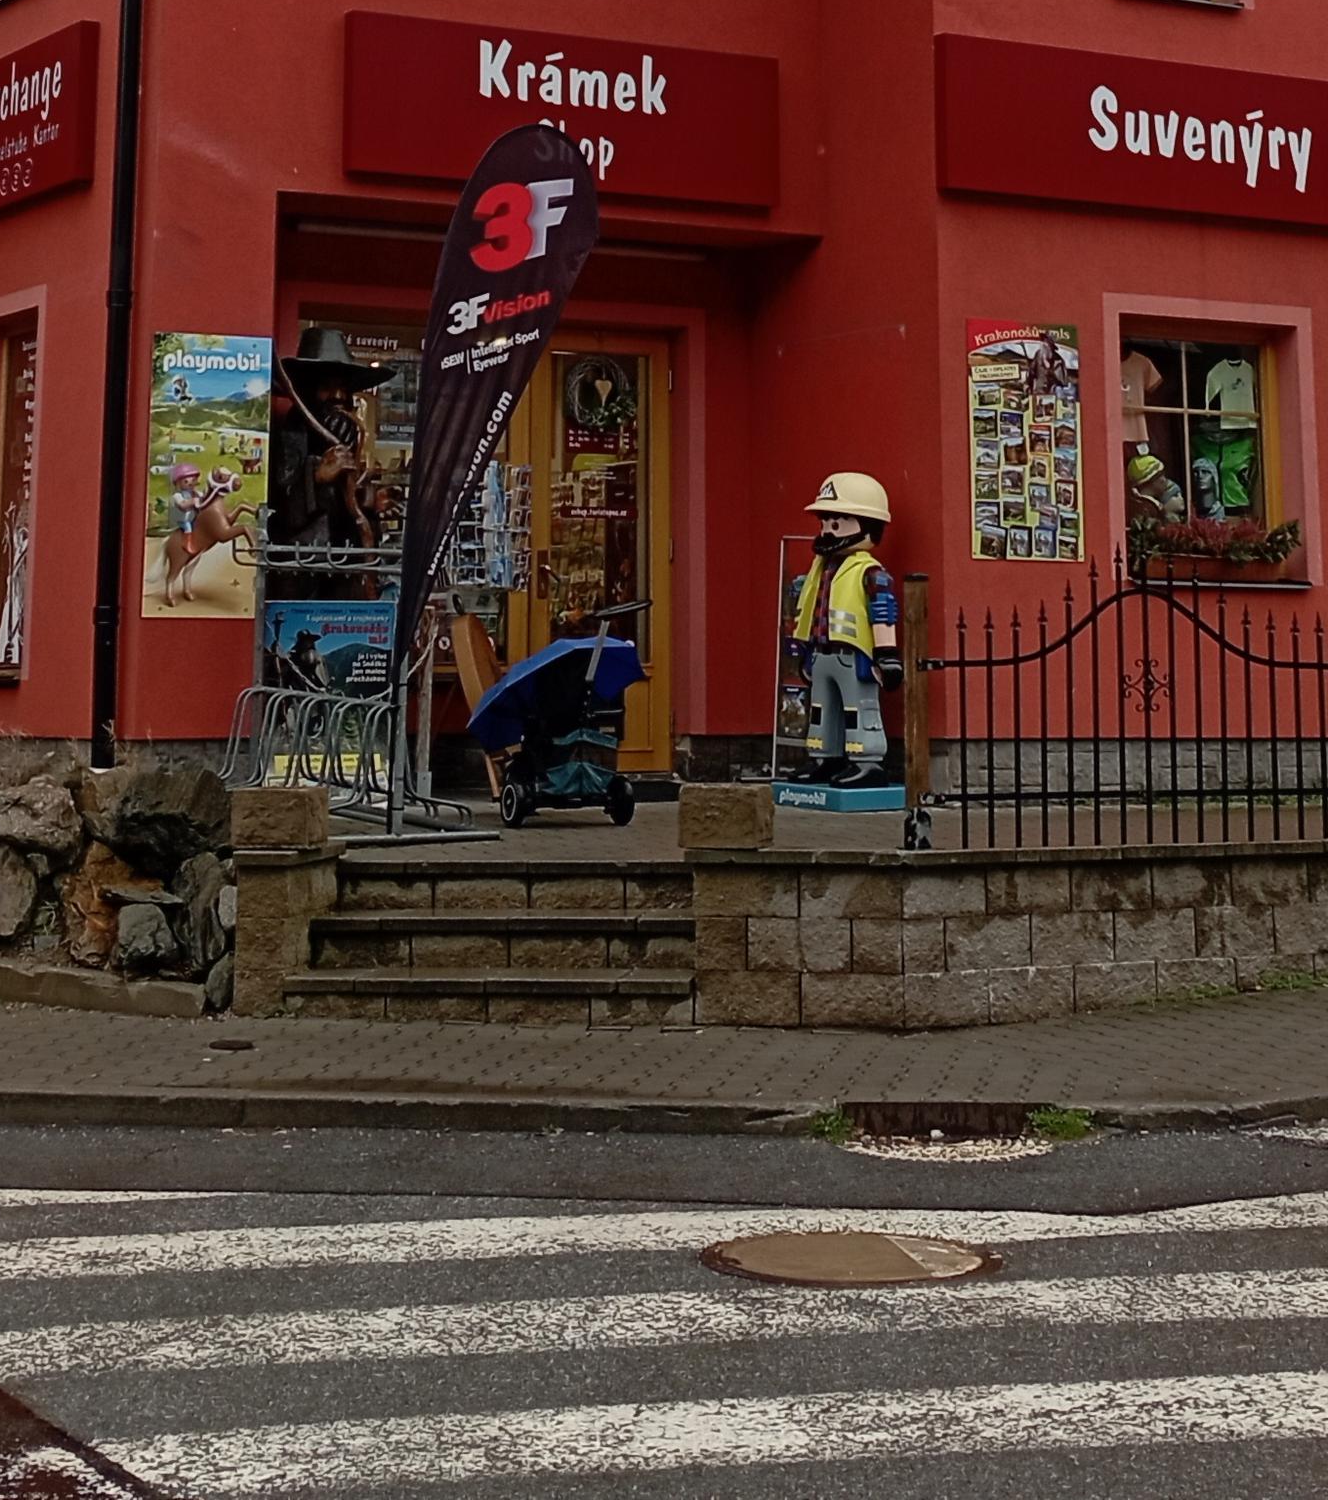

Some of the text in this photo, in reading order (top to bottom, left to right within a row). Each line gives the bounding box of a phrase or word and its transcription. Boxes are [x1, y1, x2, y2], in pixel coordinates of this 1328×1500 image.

[479, 38, 667, 116] Krámek
[1088, 85, 1312, 194] Suvenýry
[470, 178, 575, 273] 3F
[162, 348, 261, 374] playmobil
[514, 328, 540, 345] Sport
[778, 788, 827, 806] playmobil
